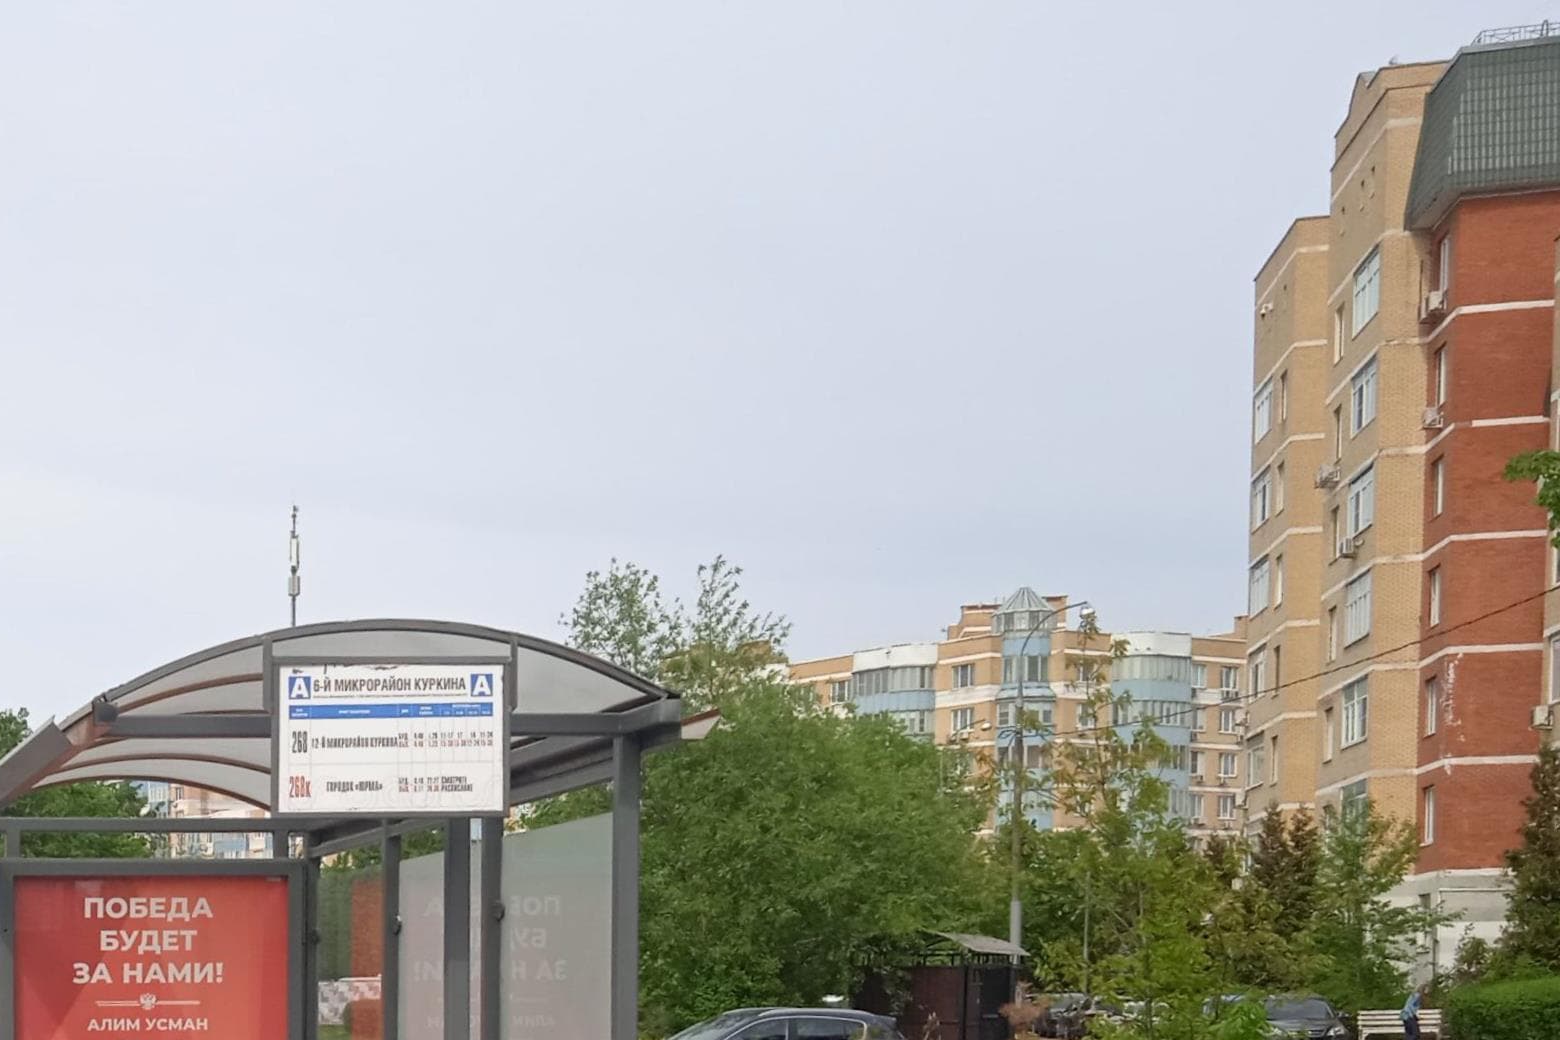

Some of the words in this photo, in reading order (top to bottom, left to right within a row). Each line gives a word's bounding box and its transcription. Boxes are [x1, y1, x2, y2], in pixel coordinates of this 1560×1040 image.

[313, 676, 331, 693] 6-Й
[334, 675, 412, 692] МИКРОРАЙОН
[414, 676, 467, 691] КУРКИНА
[291, 730, 308, 754] 268
[83, 896, 214, 922] ПОБЕДА
[99, 929, 199, 955] БУДЕТ
[72, 962, 113, 984] ЗА
[122, 961, 224, 984] НАМИ!
[86, 1017, 141, 1032] АЛИМ
[145, 1016, 209, 1031] УСМАН
